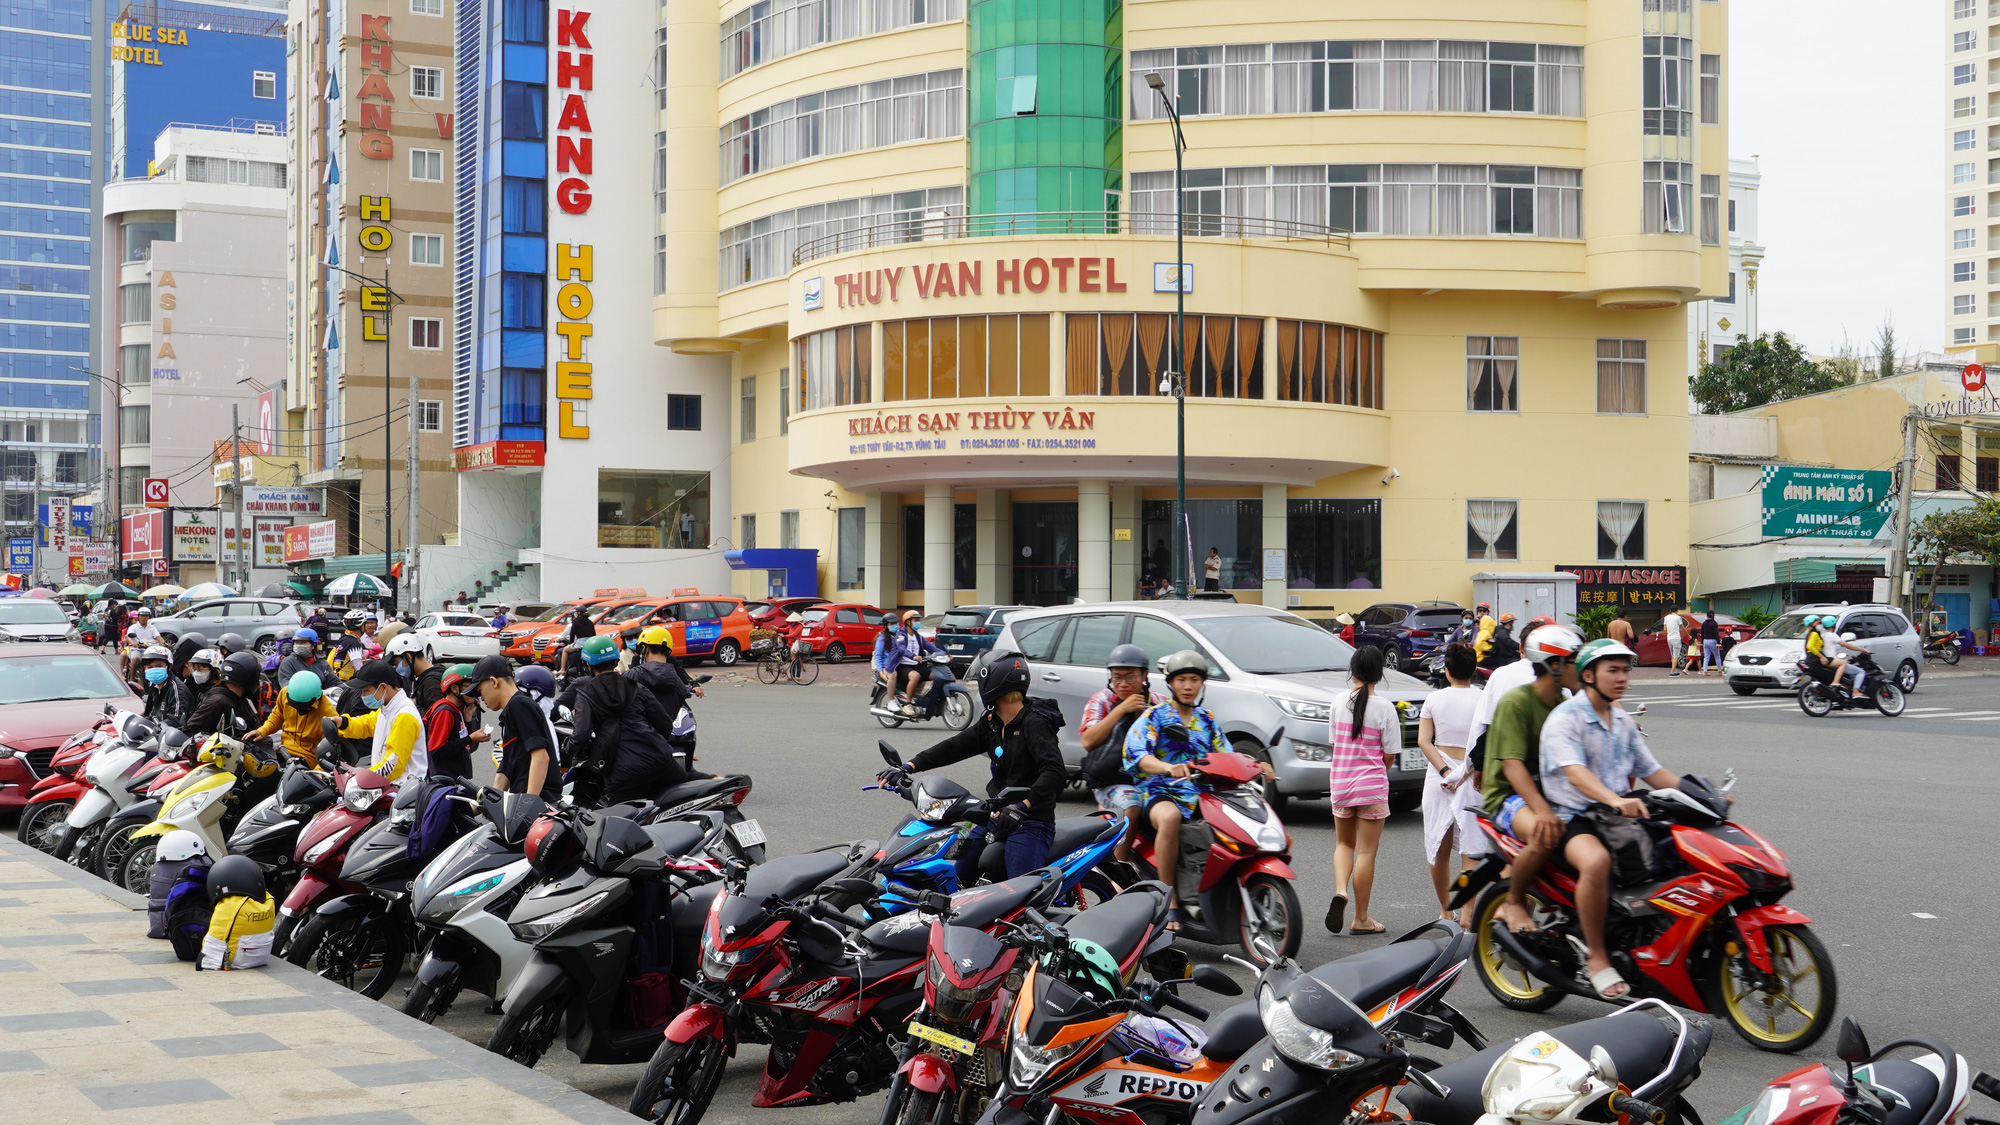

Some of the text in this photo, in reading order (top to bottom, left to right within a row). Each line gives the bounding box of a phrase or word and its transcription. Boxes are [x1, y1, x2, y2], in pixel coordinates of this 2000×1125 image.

[112, 22, 188, 46] BLUE SEA
[112, 45, 163, 65] HOTEL
[356, 14, 395, 160] KHANG
[556, 8, 593, 215] KHANG
[834, 257, 1128, 308] THUY VAN HOTEL
[158, 270, 176, 359] ASIA
[556, 243, 594, 440] HOTEL
[153, 368, 180, 380] HOTEL
[848, 404, 1095, 436] KHÁCH SẠN THÙY VÂN
[259, 492, 286, 500] KHÁCH
[1816, 483, 1844, 502] MÀU
[1848, 483, 1865, 502] SỐ
[1867, 488, 1872, 502] 1
[246, 500, 320, 511] CHÂU KHANG VŨNG TÀU
[258, 522, 271, 531] CHÂU
[1796, 514, 1861, 525] MINILAB
[174, 526, 216, 535] MEKONG
[12, 545, 32, 554] BLUE
[265, 546, 283, 554] HOTEL
[15, 556, 30, 564] SEA
[1563, 569, 1680, 584] ODY MASSAGE
[1580, 591, 1618, 603] 底按摩
[1629, 590, 1676, 604] 발마사지
[606, 843, 624, 854] HONDA
[796, 976, 838, 1009] SATRIA
[1046, 1000, 1064, 1013] HONDA
[1065, 1103, 1127, 1117] SONIC
